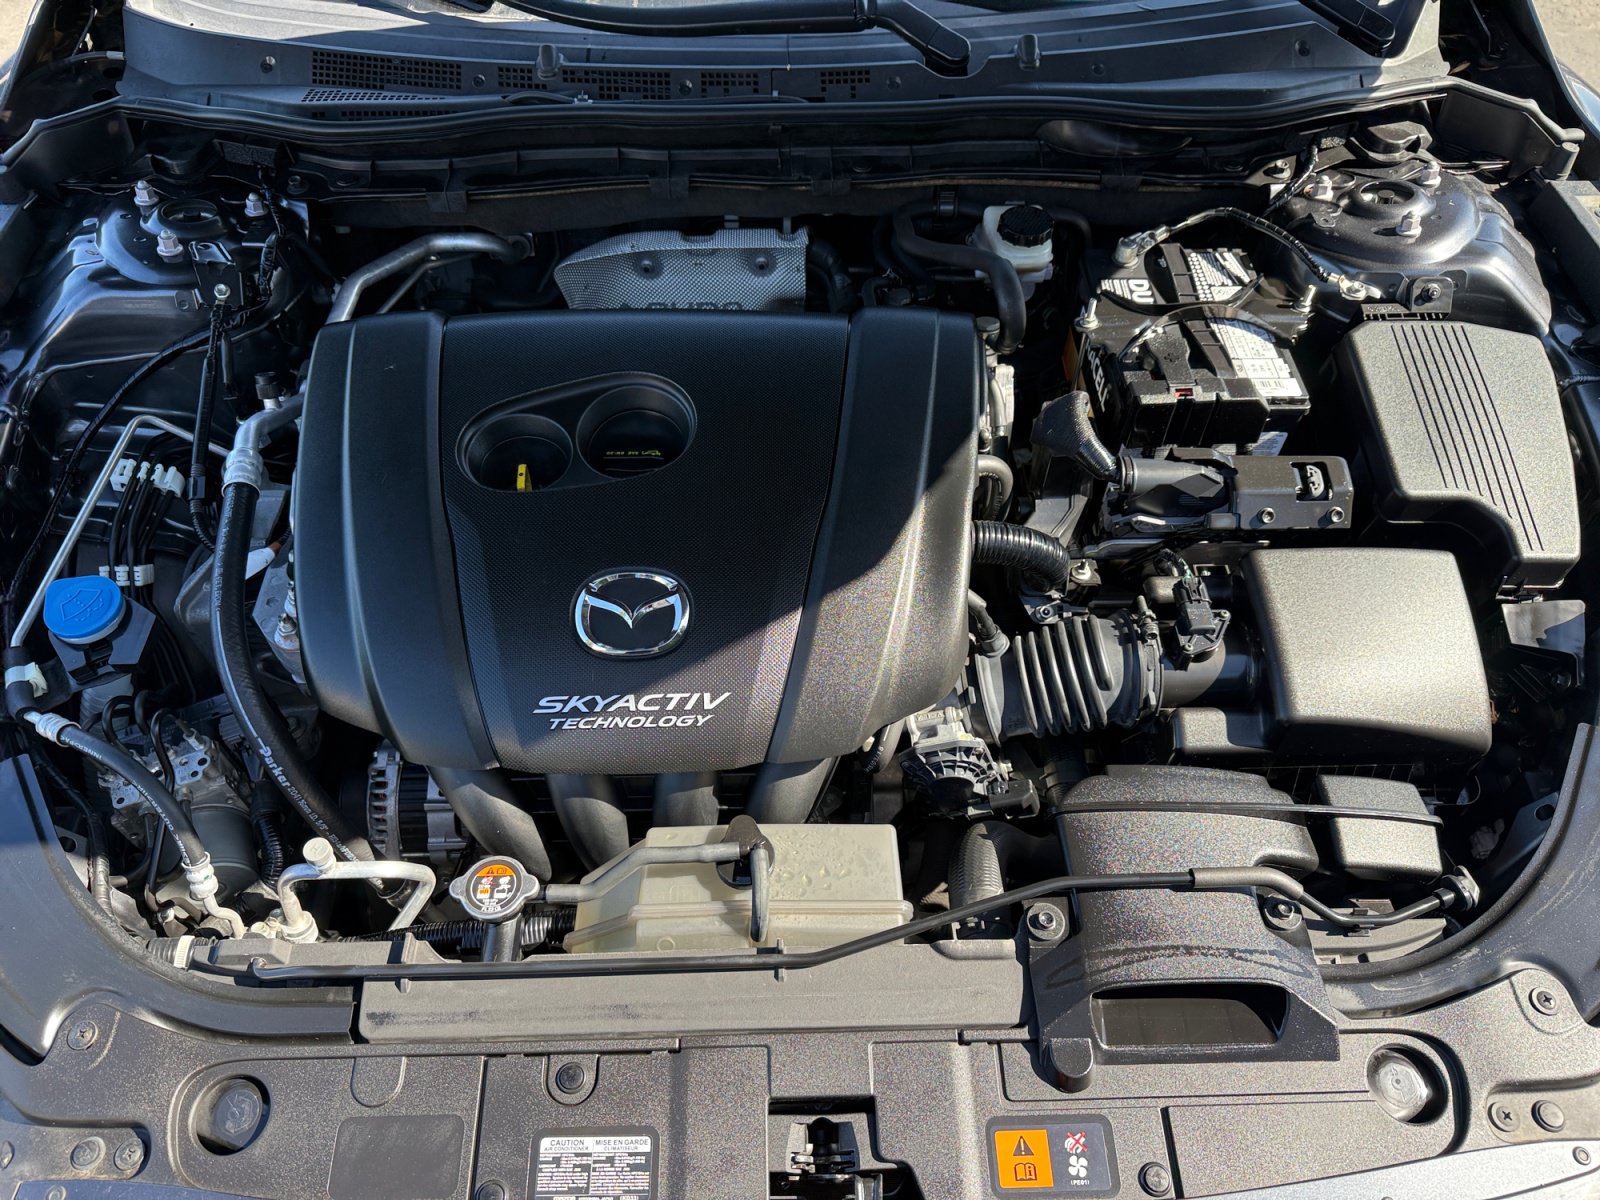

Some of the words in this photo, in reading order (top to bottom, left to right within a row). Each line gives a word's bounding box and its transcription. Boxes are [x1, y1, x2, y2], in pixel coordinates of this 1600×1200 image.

[532, 692, 732, 714] SKYACTIV
[549, 714, 715, 730] TECHNOLOGY
[259, 746, 291, 787] Parker
[624, 1138, 649, 1146] GARDE
